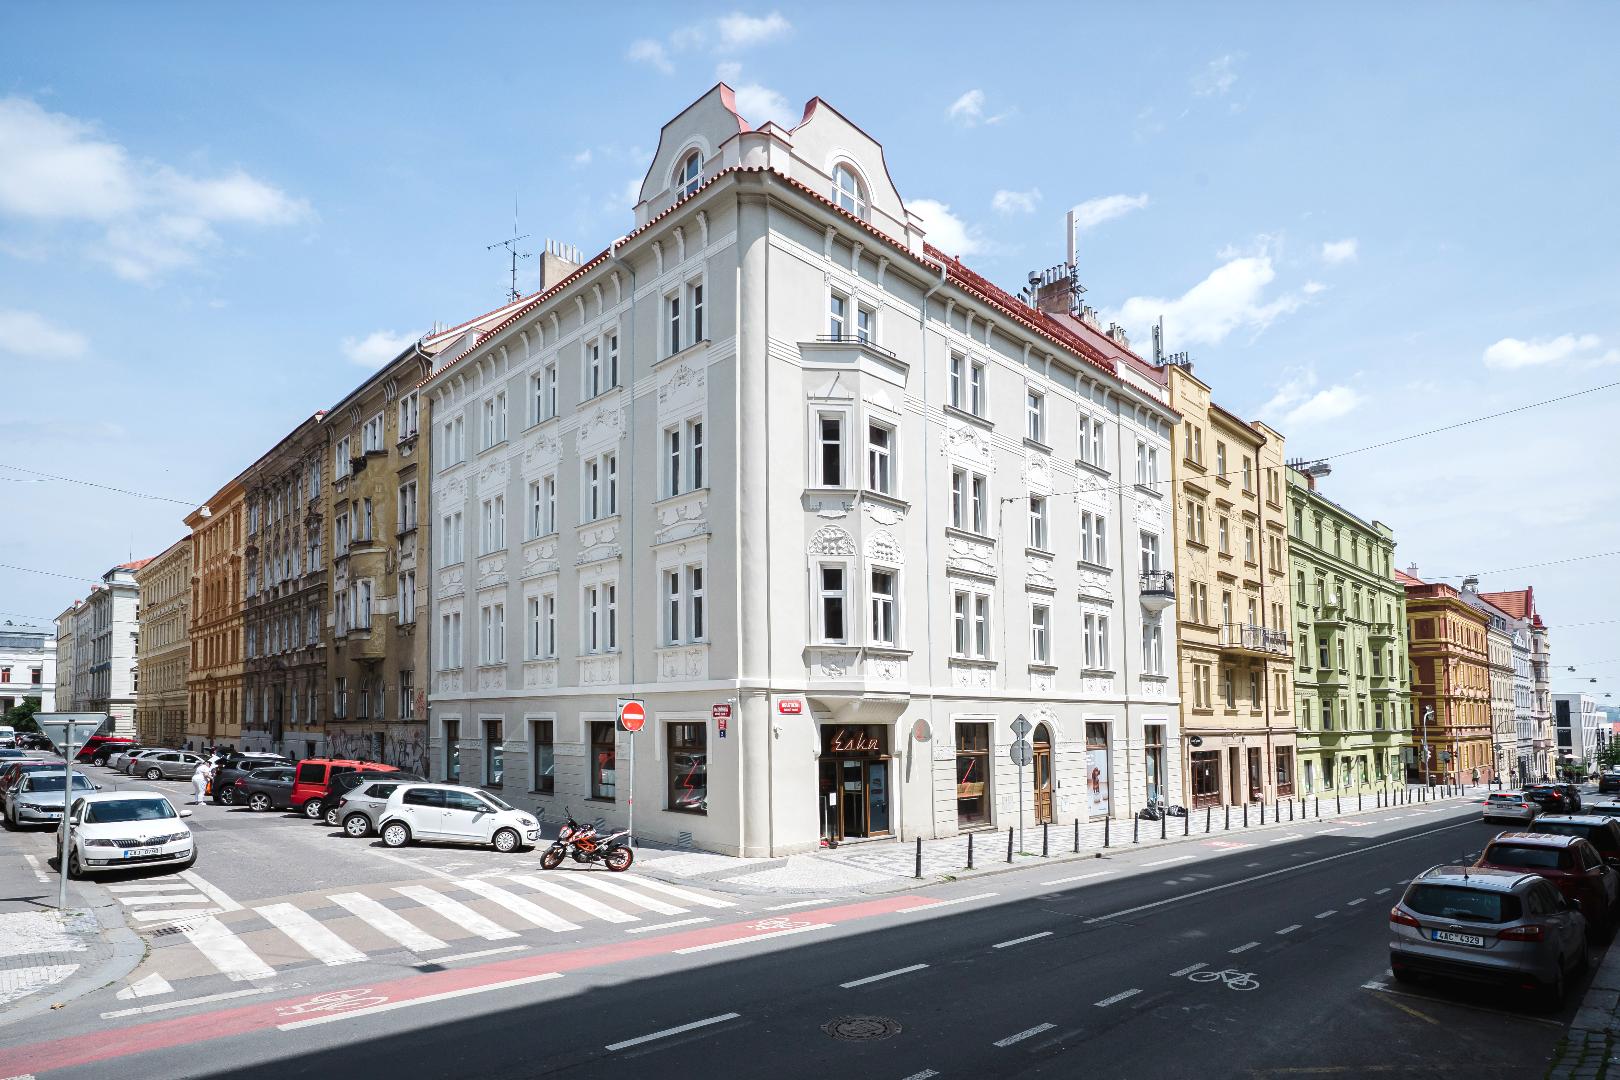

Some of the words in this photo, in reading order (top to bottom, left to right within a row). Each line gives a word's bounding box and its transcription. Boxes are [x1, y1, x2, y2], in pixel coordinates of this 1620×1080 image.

[835, 729, 879, 751] Eska
[1439, 931, 1454, 941] 4AC
[1460, 933, 1480, 945] 4329
